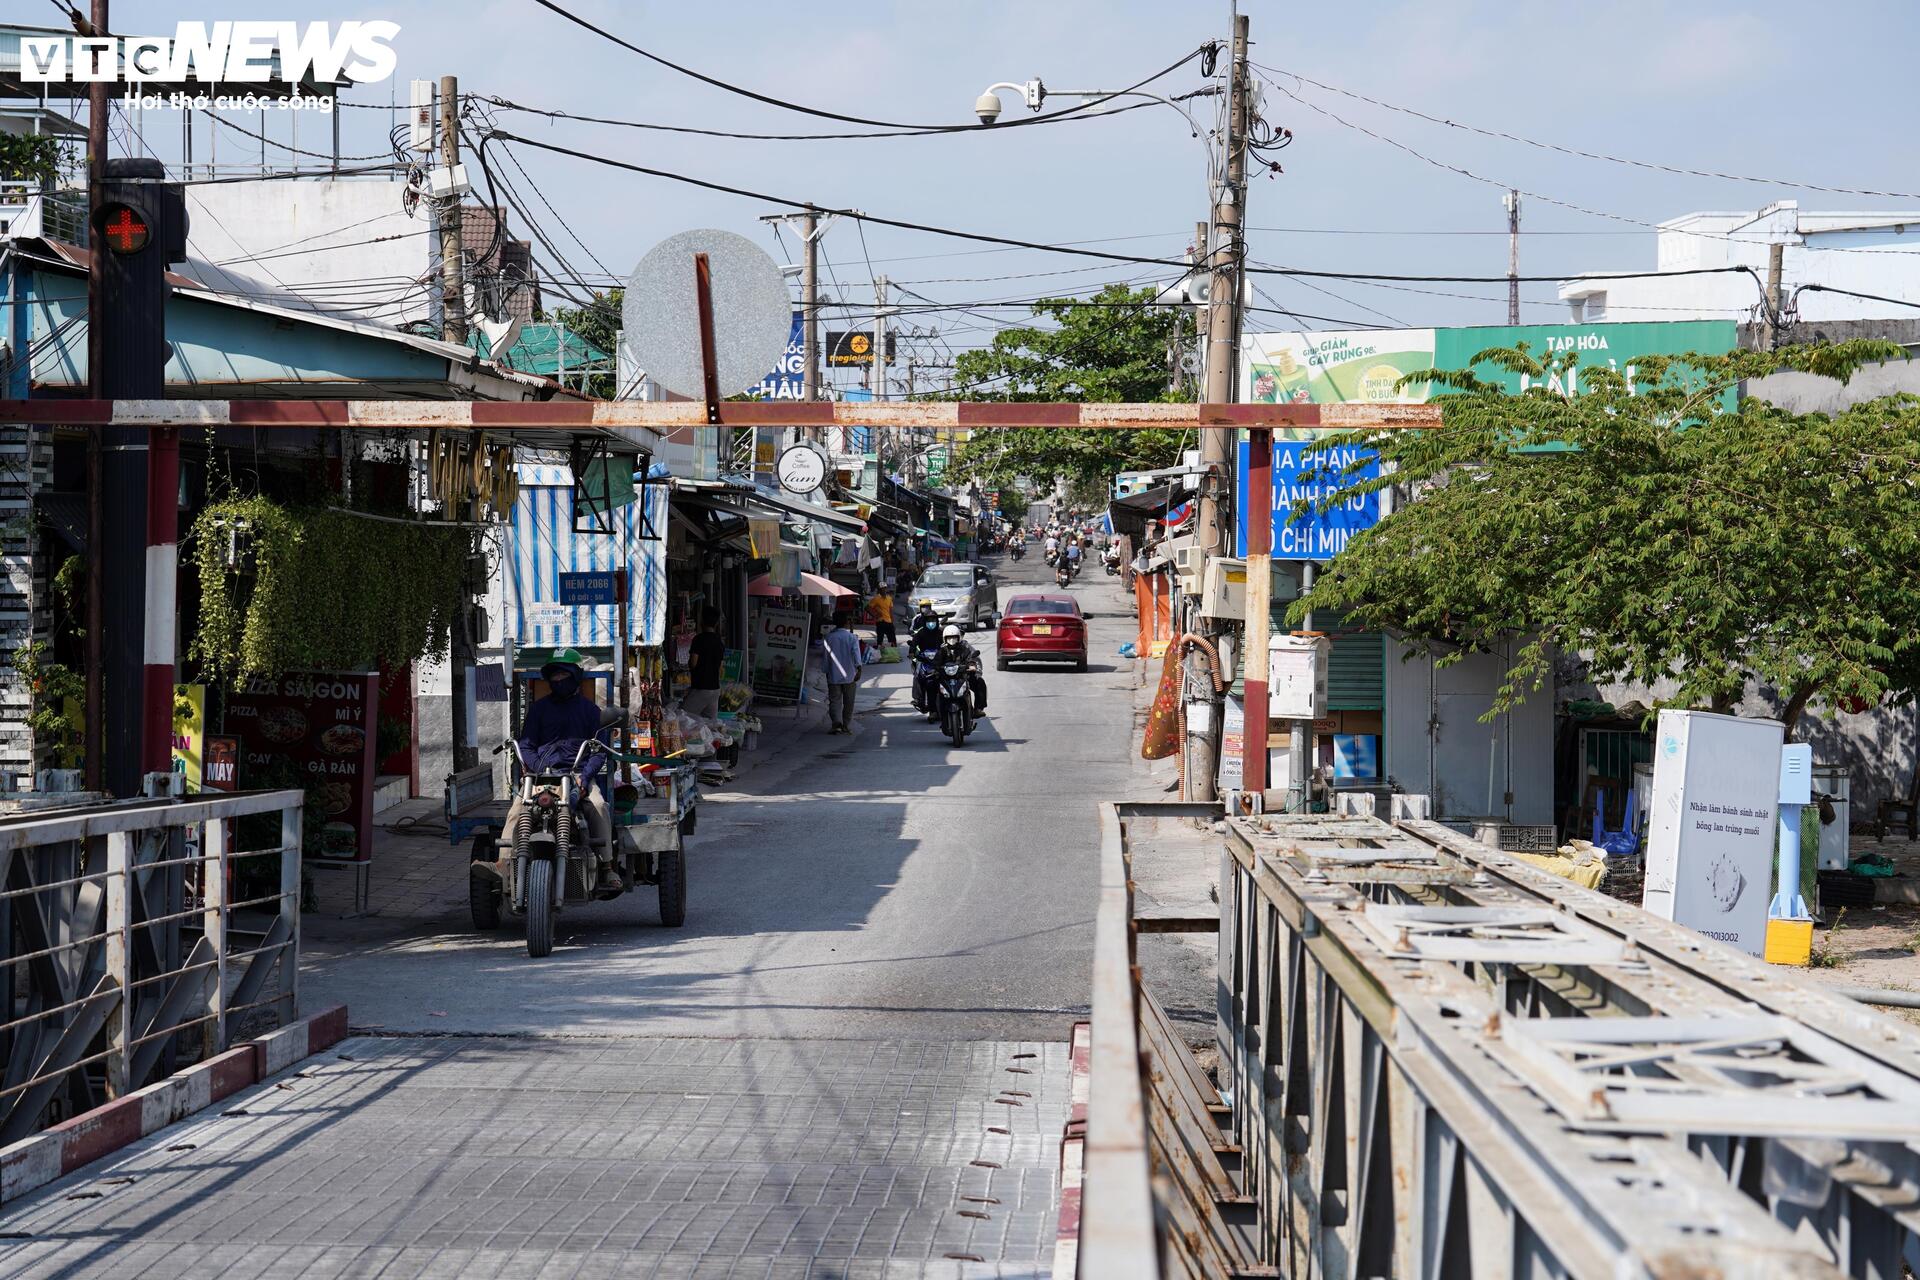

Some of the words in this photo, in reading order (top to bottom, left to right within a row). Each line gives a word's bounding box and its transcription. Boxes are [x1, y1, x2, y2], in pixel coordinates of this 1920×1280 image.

[1320, 337, 1348, 352] GIẢM
[1547, 336, 1574, 353] TẠP
[1577, 332, 1609, 350] HÓA
[1333, 347, 1363, 363] RỤNG
[1272, 449, 1295, 474] ỊA
[1271, 478, 1319, 512] HÀNH
[1281, 520, 1315, 553] CHÍ
[1319, 527, 1366, 553] MIN
[230, 705, 259, 717] PIZZA
[335, 707, 350, 721] MÌ
[353, 707, 362, 721] Ý
[248, 752, 272, 765] CAY
[308, 758, 327, 774] GÀ
[330, 758, 356, 775] RÁN
[206, 760, 234, 782] MÁY
[1713, 822, 1724, 831] lan
